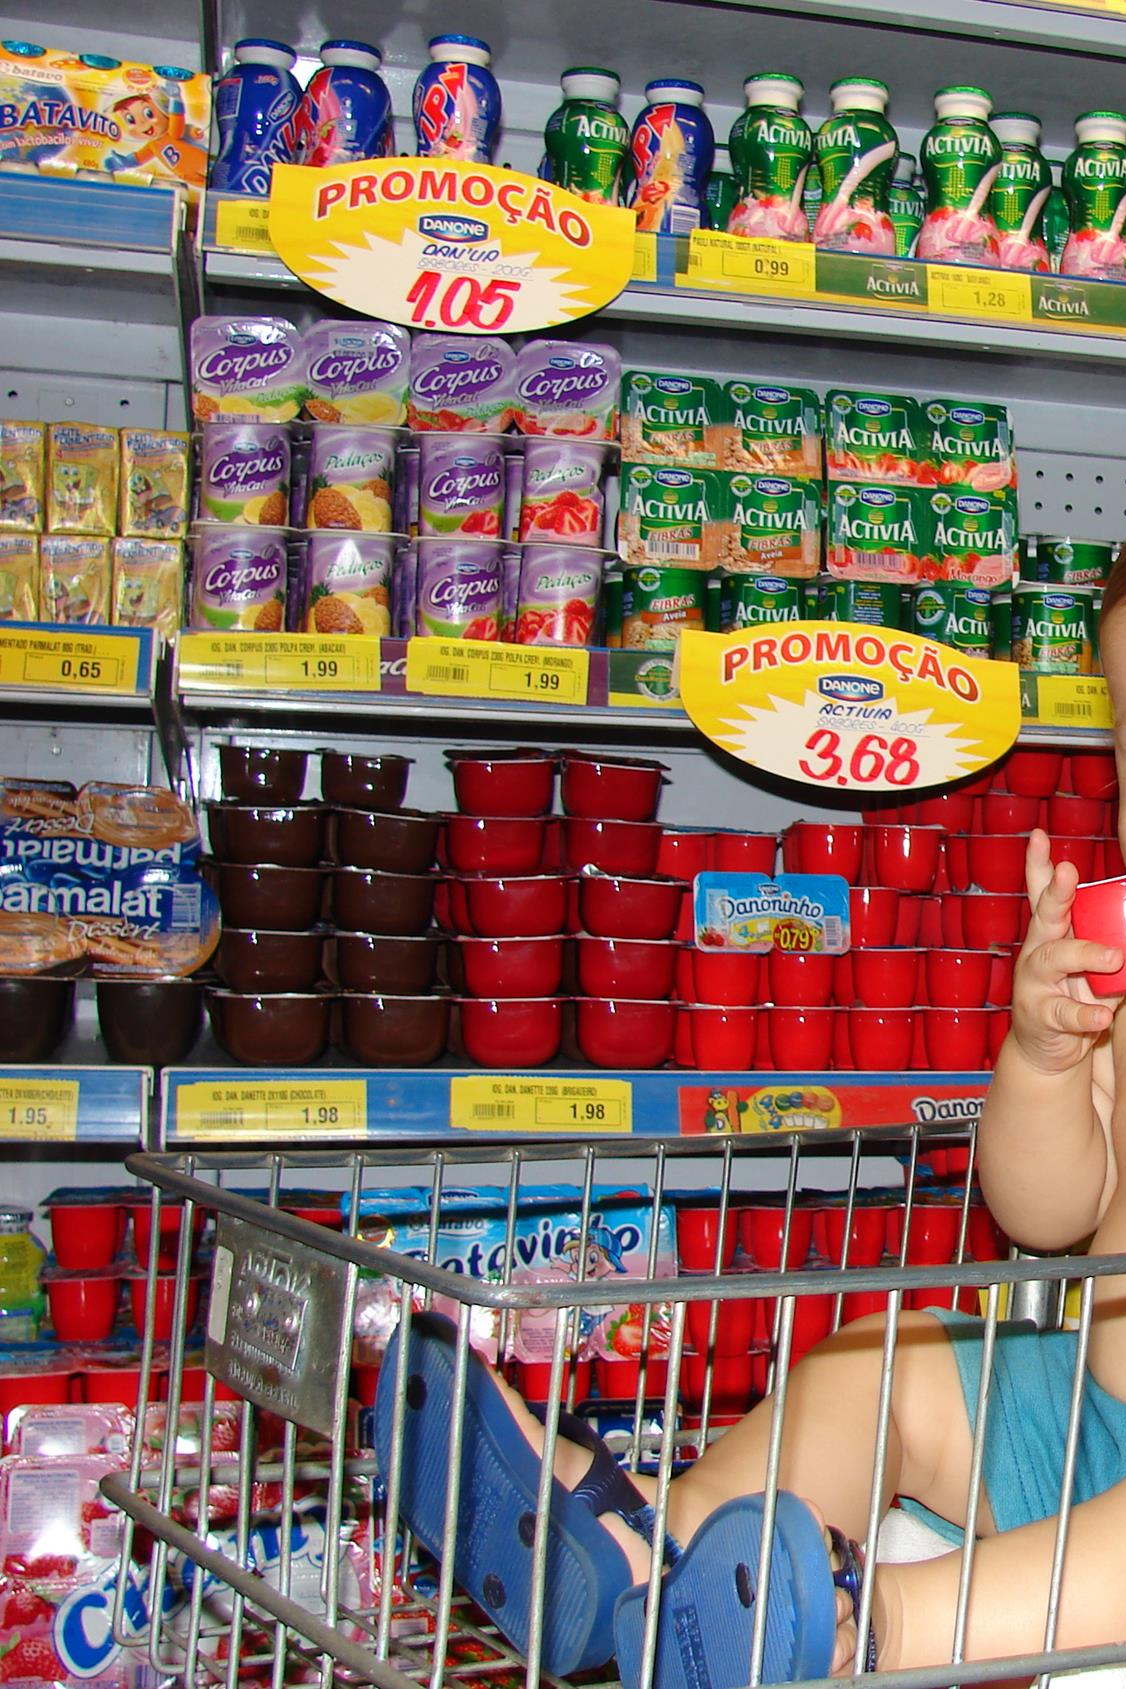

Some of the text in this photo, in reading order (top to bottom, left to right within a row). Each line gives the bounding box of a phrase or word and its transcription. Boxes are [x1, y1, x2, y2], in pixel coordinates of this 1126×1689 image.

[0, 103, 121, 140] BATAVITO
[758, 121, 812, 150] ACTIVIA
[813, 125, 857, 148] TIVIA
[926, 136, 992, 156] ACTIVIA
[1000, 160, 1040, 181] TIVIA
[317, 171, 592, 248] PROMOÇÃO
[423, 217, 485, 237] DANONE
[867, 275, 919, 296] ACTIVIA
[406, 270, 522, 330] 1.05
[1039, 296, 1089, 316] ACTIVIA
[200, 347, 291, 382] Corpus
[310, 349, 399, 384] Corpus
[414, 365, 501, 396] Corpus
[519, 370, 607, 401] Corpus
[634, 401, 713, 427] ACTIVIA
[734, 409, 810, 435] ACTIVIA
[837, 421, 916, 449] ACTIVIA
[931, 431, 1005, 457] ACTIVIA
[210, 455, 283, 486] Corpus
[429, 467, 500, 499] Corpus
[632, 495, 711, 521] ACTIVIA
[732, 504, 809, 529] ACTIVIA
[839, 513, 919, 542] ACTIVIA
[934, 522, 1009, 549] ACTIVIA
[205, 562, 280, 591] Corpus
[430, 572, 501, 604] Corpus
[651, 594, 695, 610] FIBRAS
[735, 602, 799, 621] ACTIVIA
[662, 610, 687, 621] Aveia
[945, 613, 991, 633] ACTIV
[1025, 619, 1087, 638] ACTIVIA
[723, 633, 981, 703] PROMOÇÃO
[822, 679, 881, 696] DANONE
[818, 703, 893, 721] ACTIVIA
[799, 729, 920, 786] 3.68
[0, 881, 162, 918] armalat
[722, 897, 822, 919] Danoninho
[67, 920, 161, 941] Dessert
